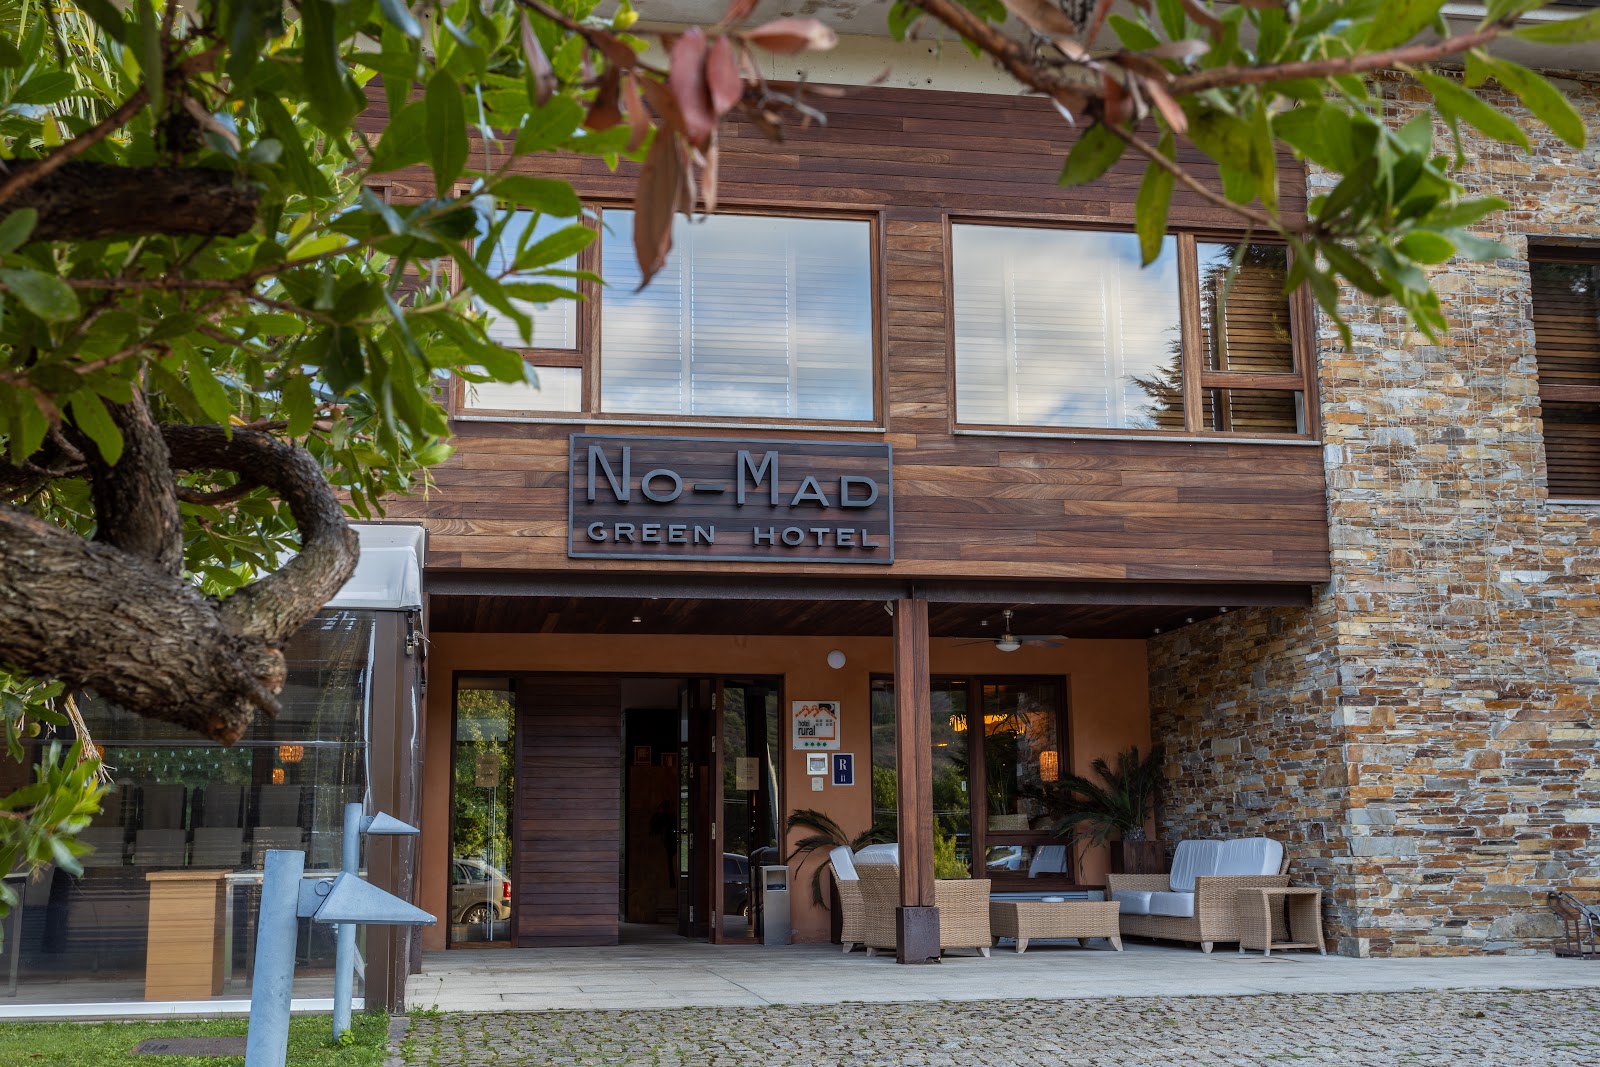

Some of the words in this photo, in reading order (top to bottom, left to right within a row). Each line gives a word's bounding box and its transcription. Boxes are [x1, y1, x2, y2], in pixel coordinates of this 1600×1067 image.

[587, 521, 715, 544] GREEN
[753, 526, 879, 549] HOTEL
[798, 725, 816, 735] rural
[839, 759, 847, 770] R
